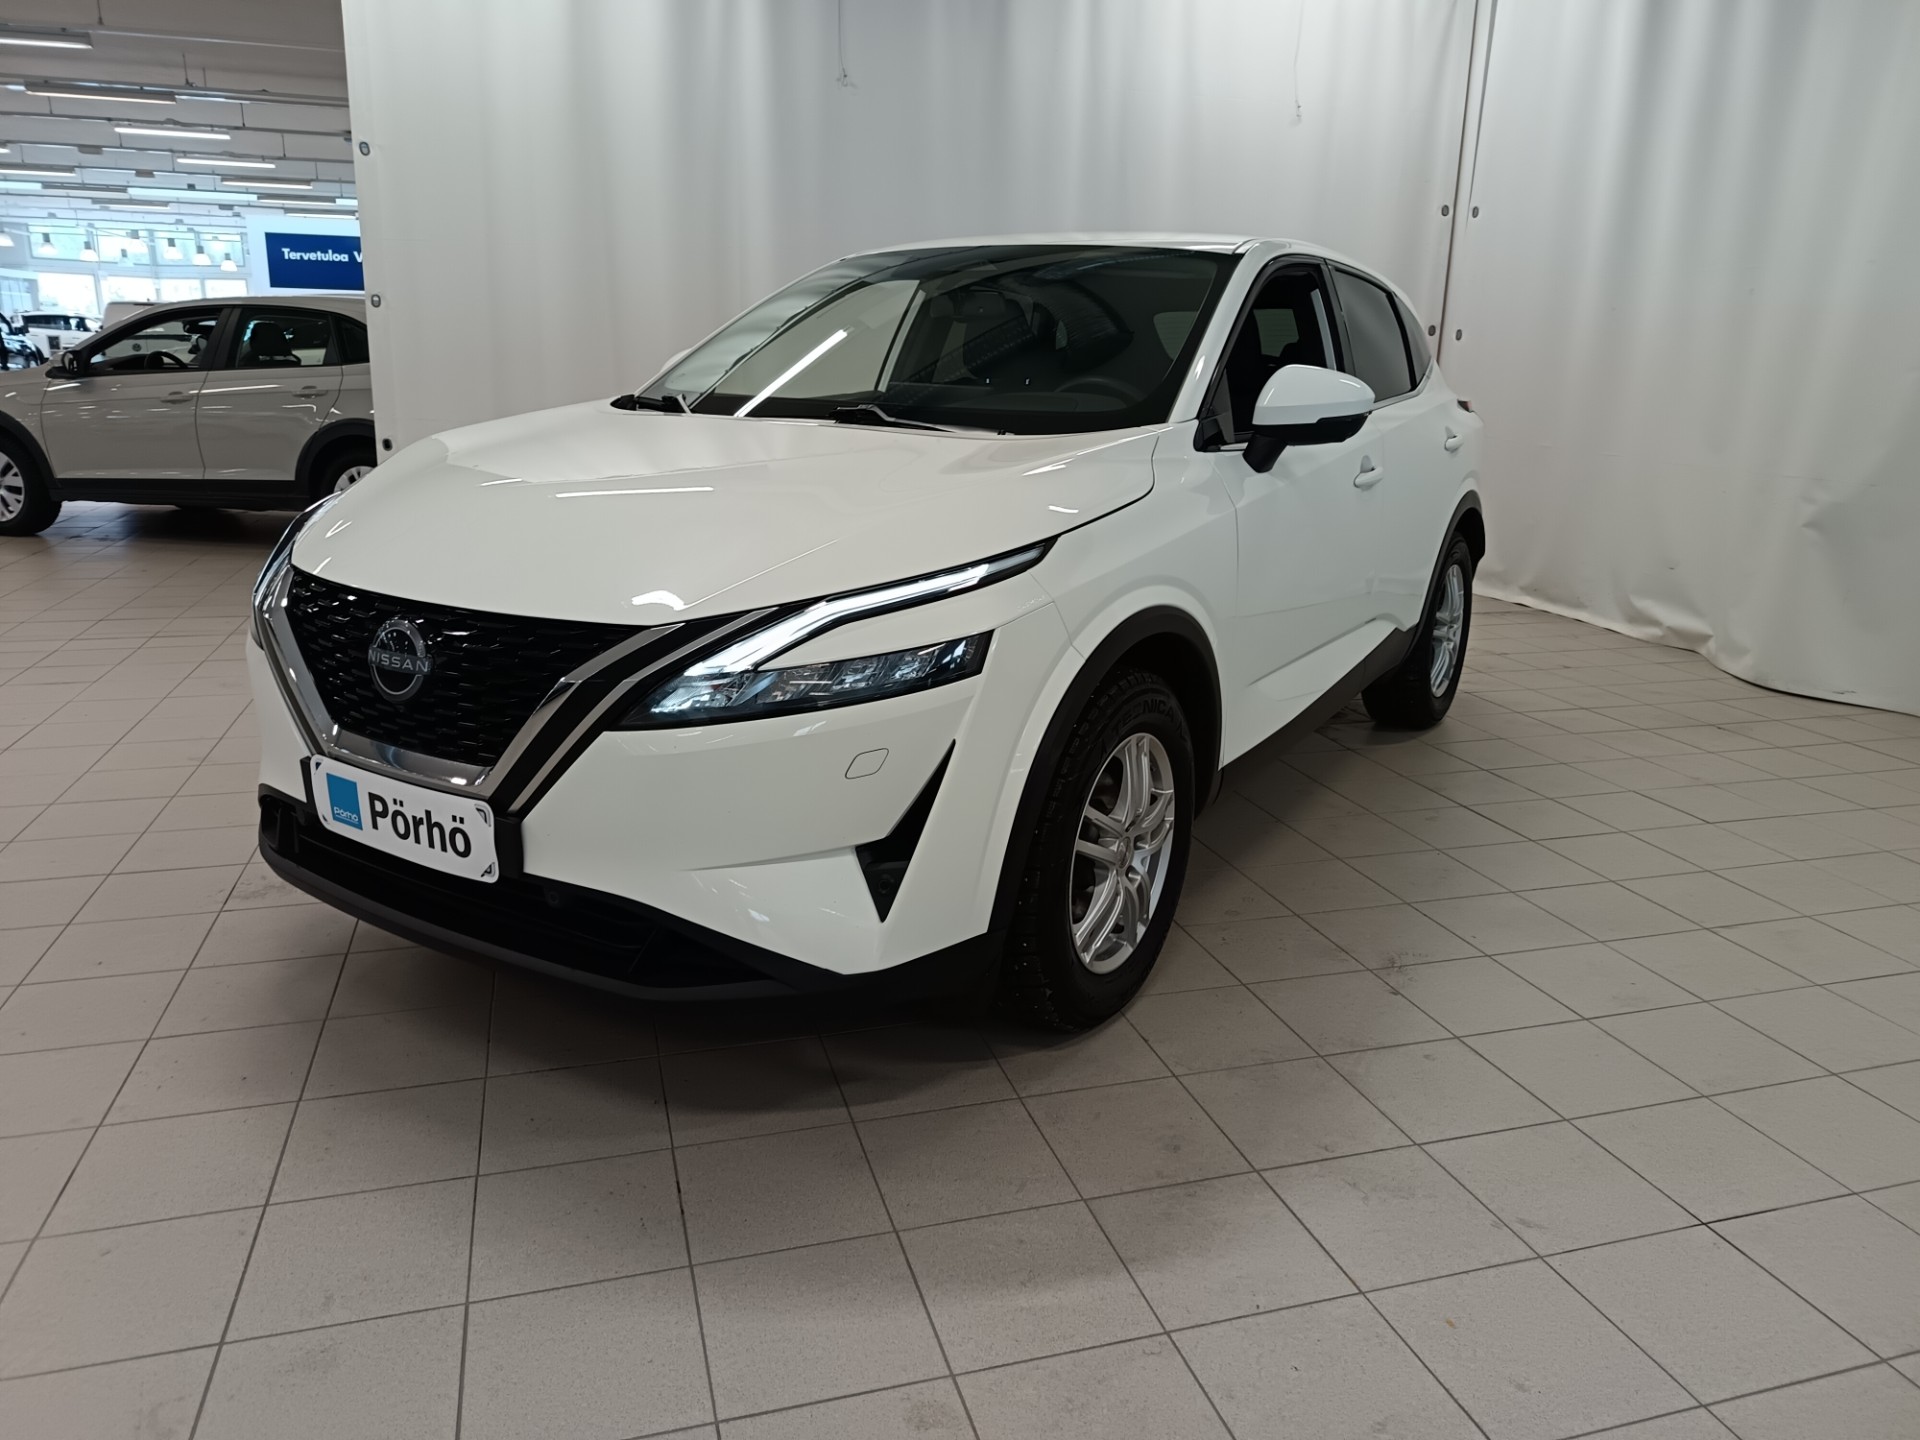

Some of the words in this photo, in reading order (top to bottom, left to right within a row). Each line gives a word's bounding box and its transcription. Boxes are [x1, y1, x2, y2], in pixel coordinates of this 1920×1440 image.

[281, 247, 349, 262] Tervetuloa
[368, 649, 429, 672] NISSAN
[368, 791, 472, 859] Pörhö
